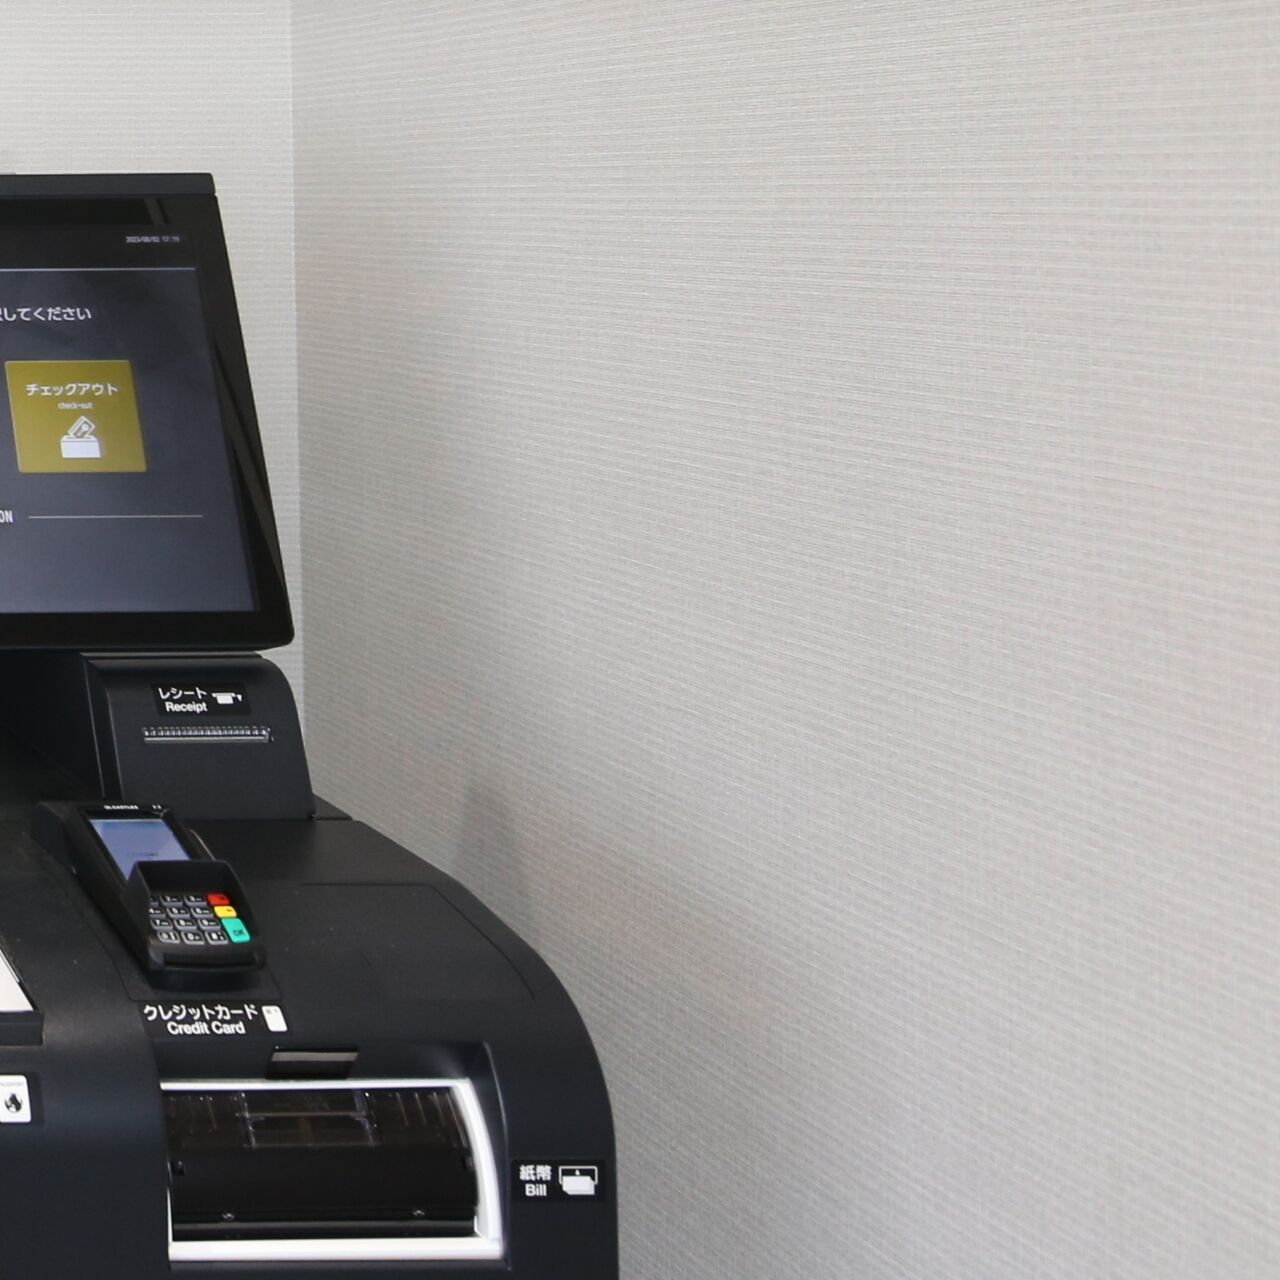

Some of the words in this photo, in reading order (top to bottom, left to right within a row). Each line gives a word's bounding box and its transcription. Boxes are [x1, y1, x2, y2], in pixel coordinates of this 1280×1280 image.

[26, 383, 118, 396] チェックアウト
[158, 687, 207, 699] レシート
[165, 702, 208, 714] Receipt
[143, 1004, 258, 1021] クレジットカード
[167, 1021, 209, 1034] Credit
[212, 1021, 245, 1034] Card
[519, 1165, 552, 1181] 紙幣
[525, 1184, 547, 1197] Bill
